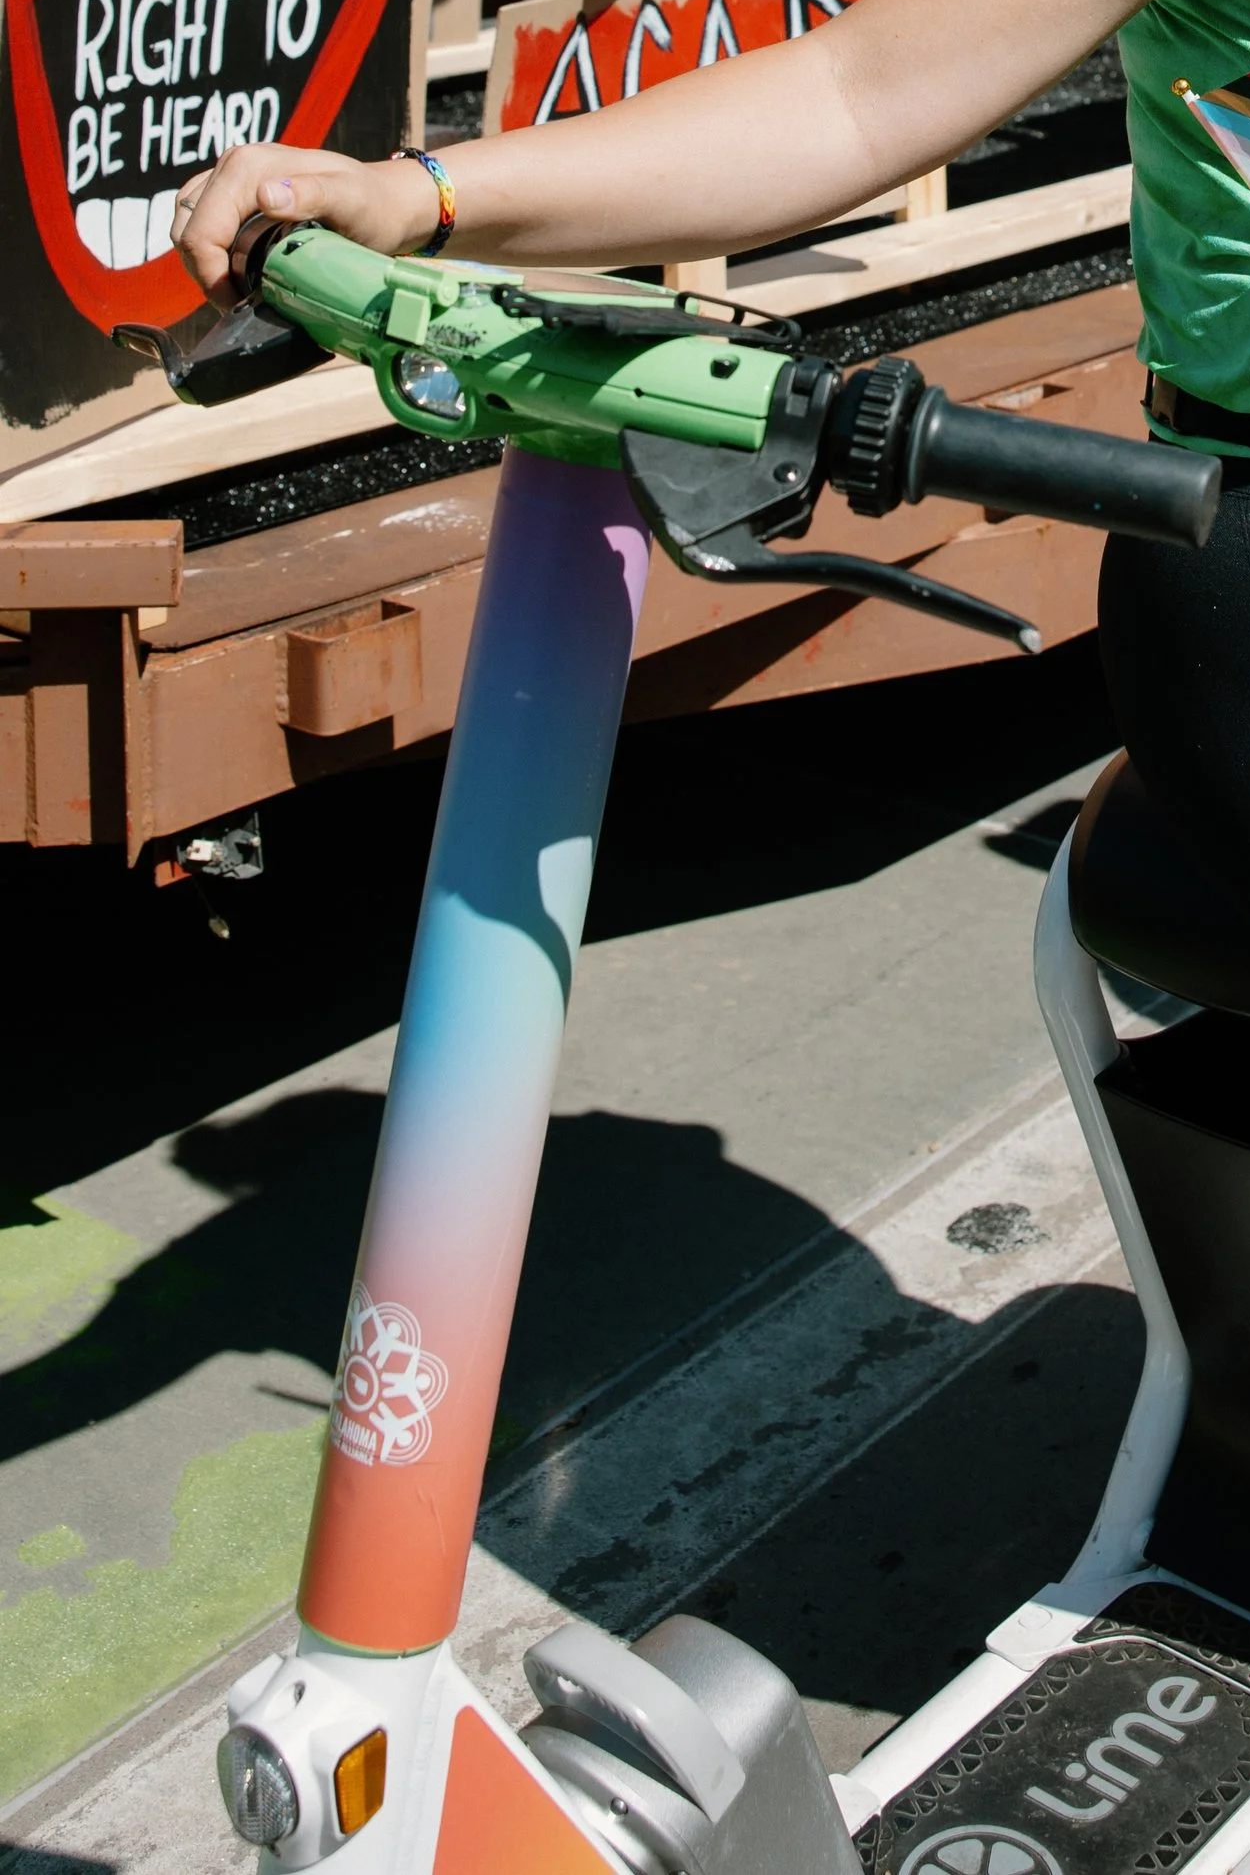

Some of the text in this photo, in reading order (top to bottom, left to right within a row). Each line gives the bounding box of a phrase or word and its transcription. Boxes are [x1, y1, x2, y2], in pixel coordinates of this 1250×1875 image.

[67, 86, 281, 195] BE HEARD
[1024, 1675, 1218, 1823] Lime
